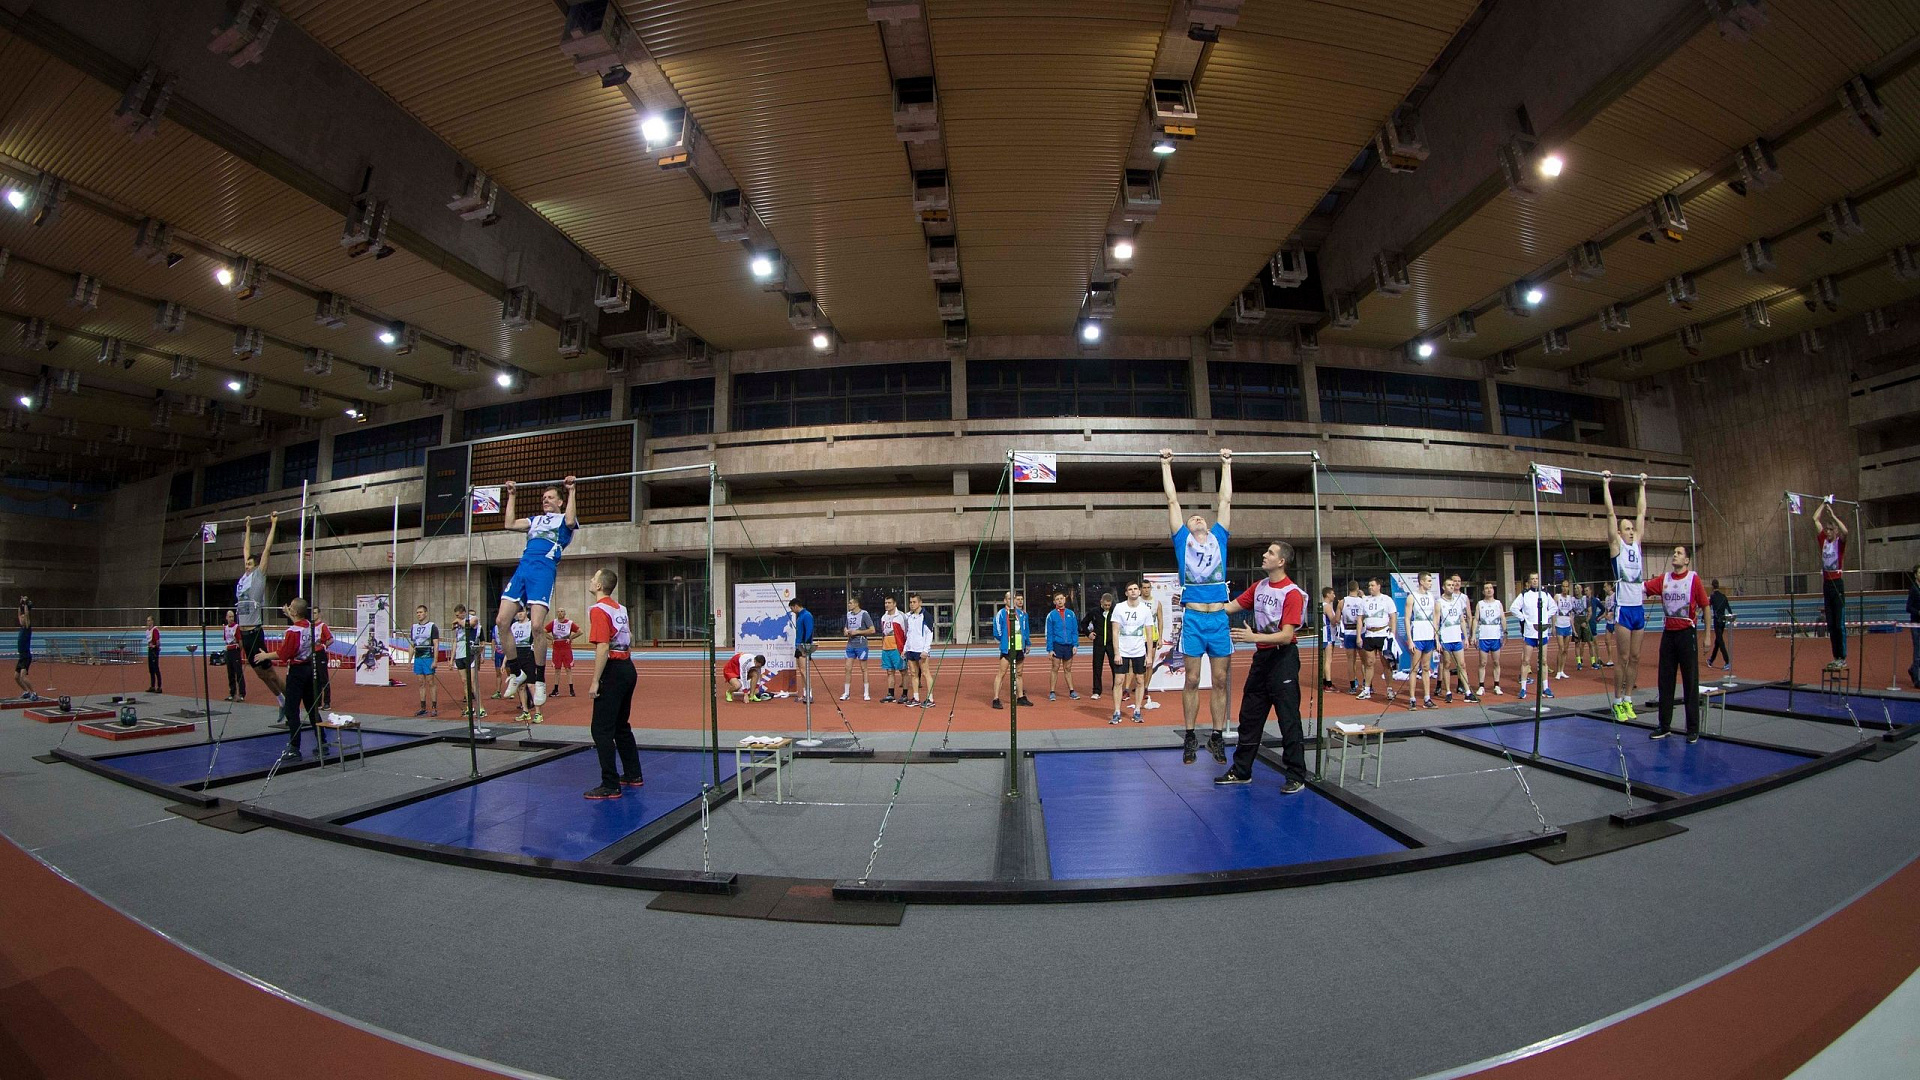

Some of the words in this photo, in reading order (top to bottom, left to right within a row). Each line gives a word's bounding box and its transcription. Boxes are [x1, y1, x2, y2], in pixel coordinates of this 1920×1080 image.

[1031, 468, 1039, 479] 3
[483, 501, 489, 511] 2
[537, 515, 555, 526] 13
[1196, 552, 1213, 568] 73
[1420, 596, 1430, 607] 87
[1368, 603, 1378, 611] 81
[1124, 611, 1138, 621] 74
[1485, 609, 1495, 618] 82
[416, 625, 427, 635] 97
[557, 623, 567, 632] 92
[766, 659, 795, 669] cska.ru
